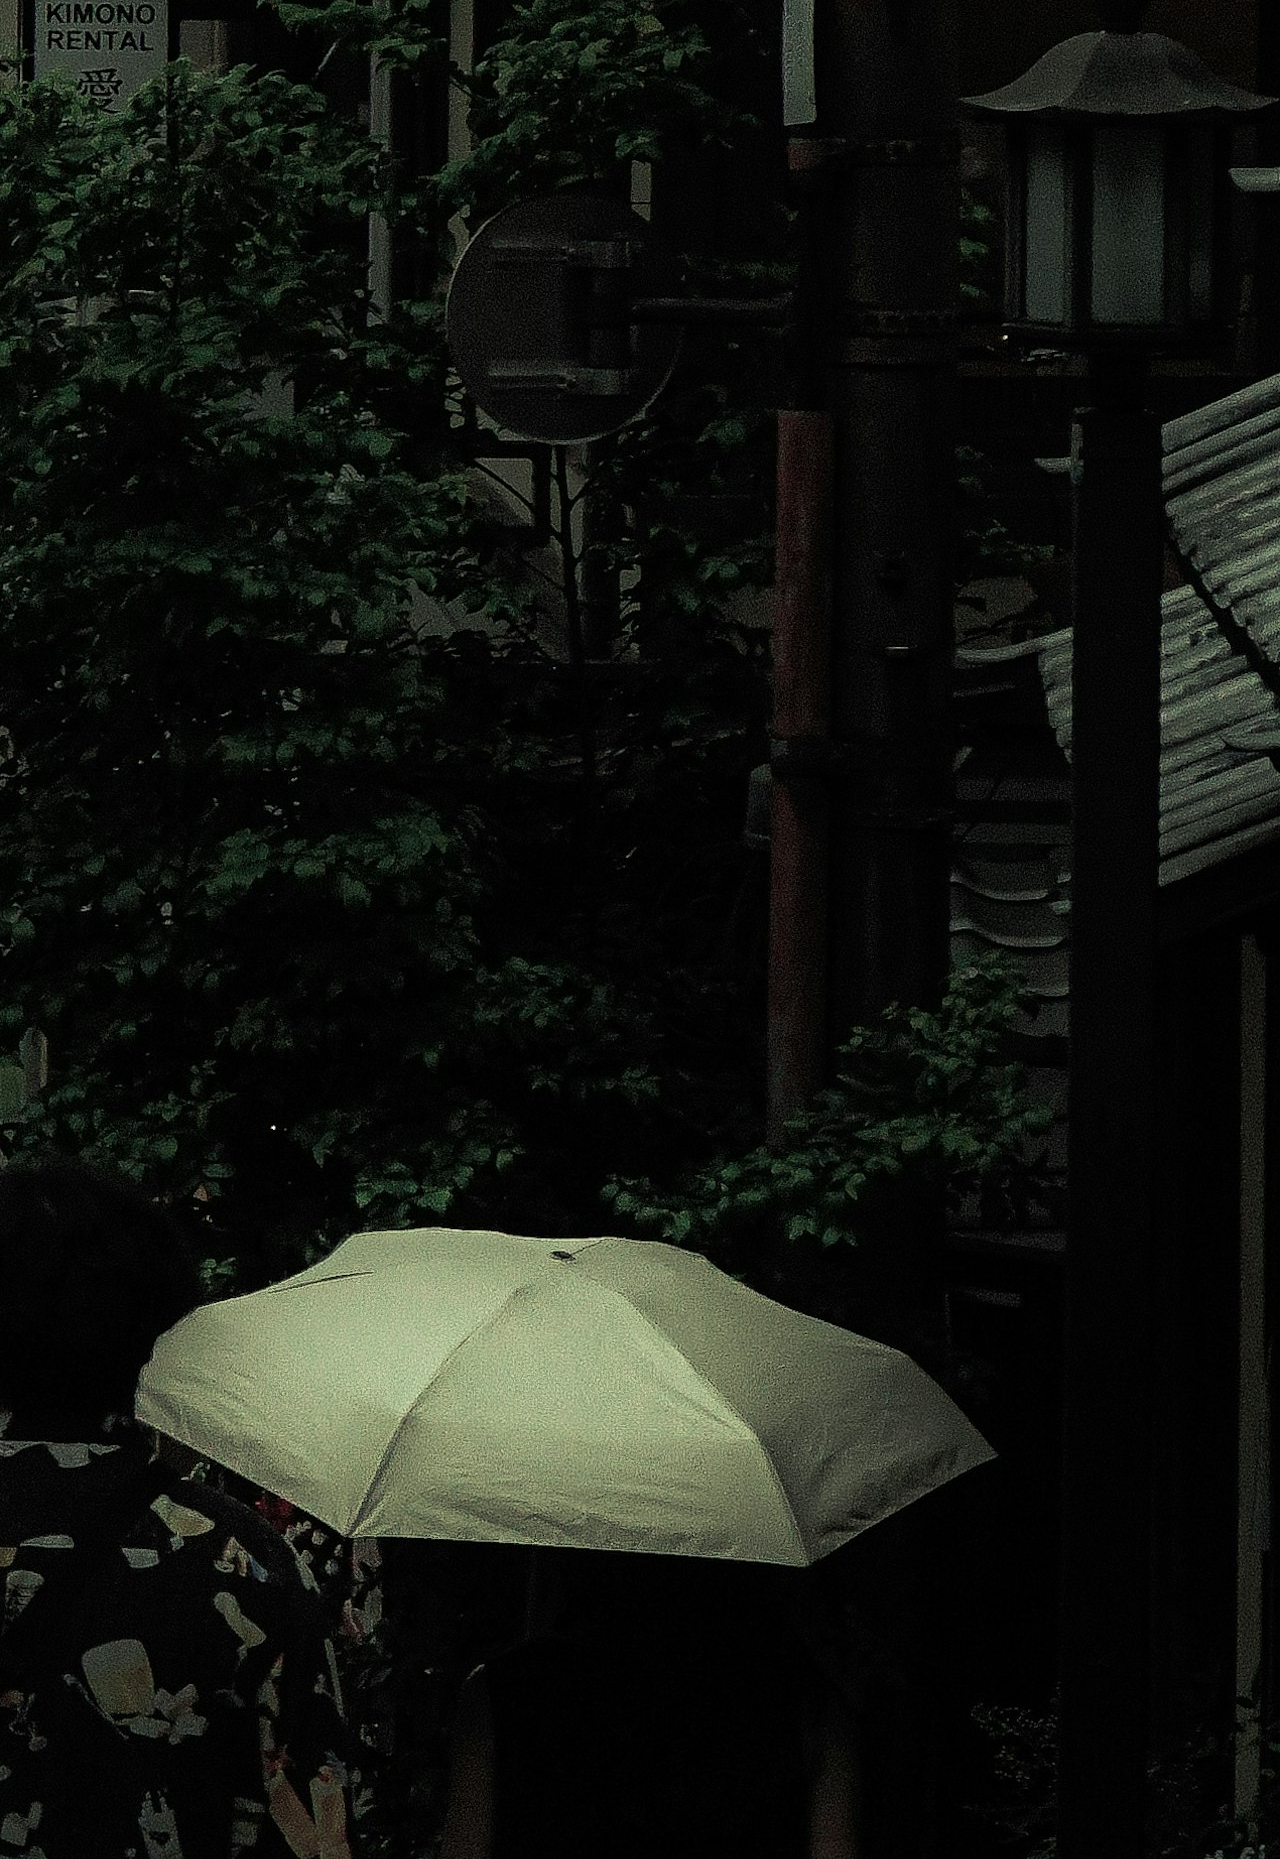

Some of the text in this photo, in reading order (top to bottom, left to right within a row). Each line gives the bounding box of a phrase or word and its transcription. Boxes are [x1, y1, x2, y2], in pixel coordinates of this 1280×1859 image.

[46, 3, 156, 24] KIMONO
[47, 30, 155, 51] RENTAL
[76, 67, 123, 114] 愛
